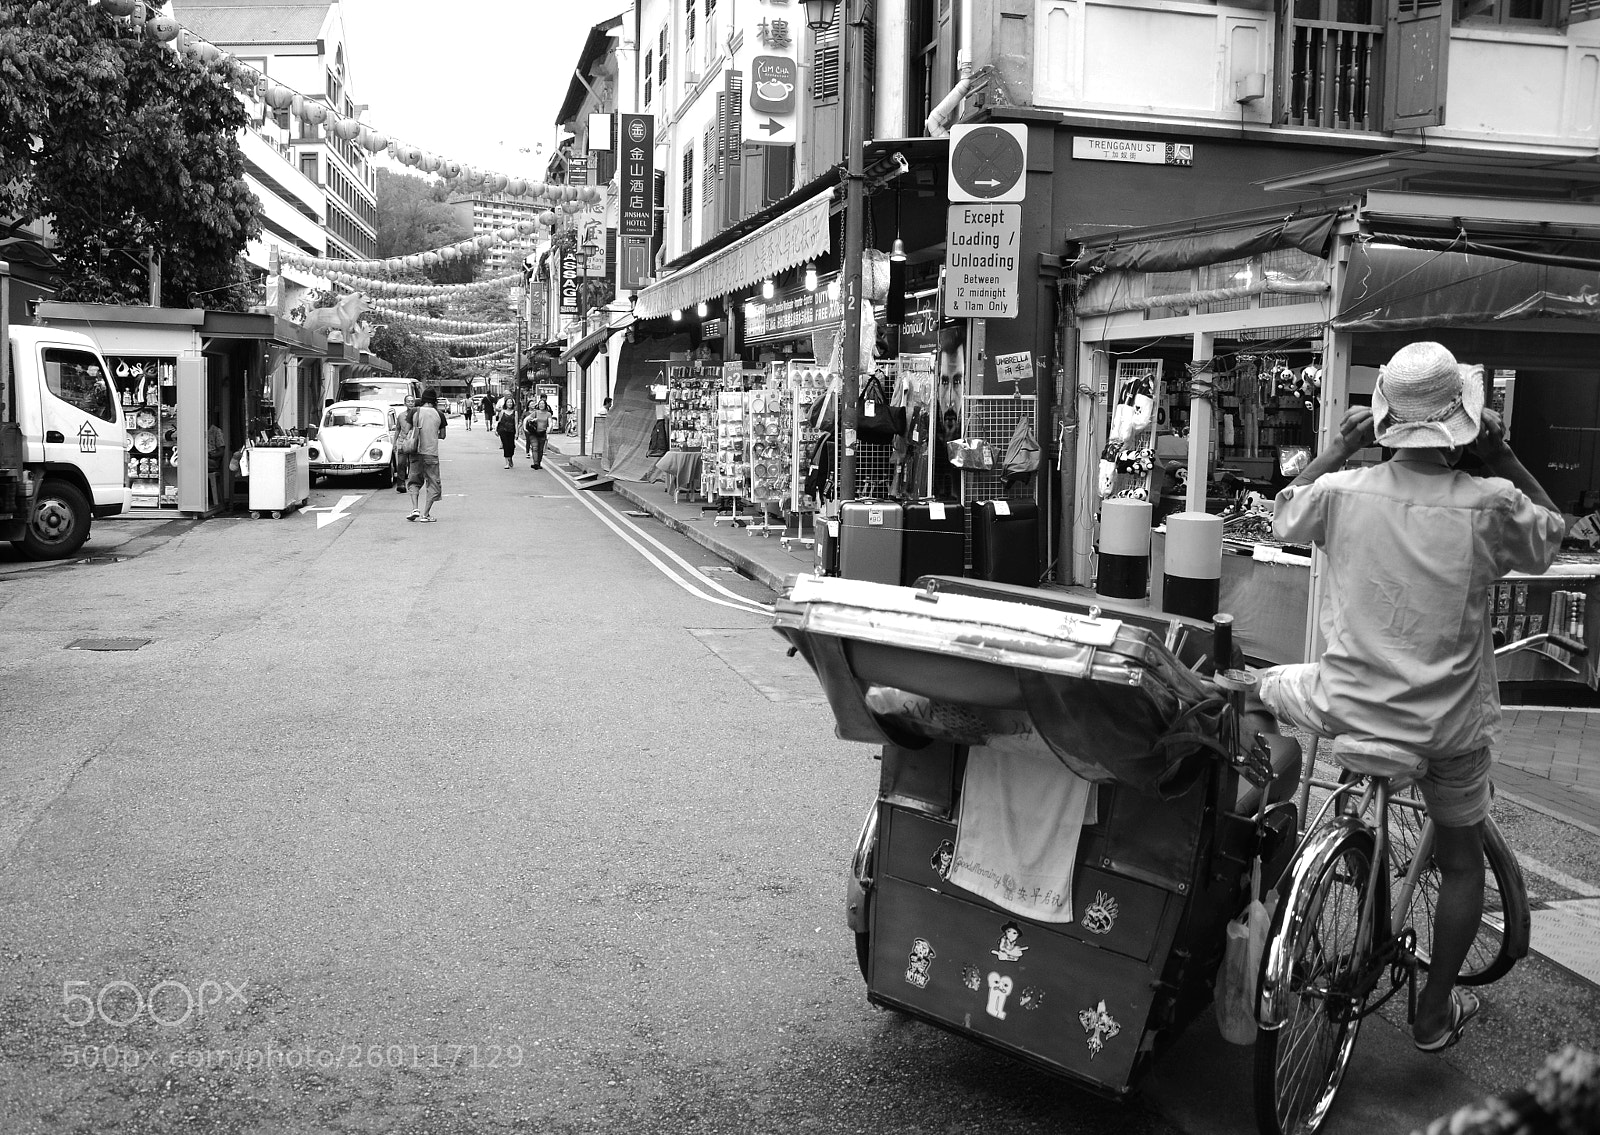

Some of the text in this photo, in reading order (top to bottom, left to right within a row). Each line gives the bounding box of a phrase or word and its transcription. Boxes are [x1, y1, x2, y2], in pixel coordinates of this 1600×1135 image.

[757, 60, 790, 80] YUM CHA
[1088, 139, 1157, 153] TRENGGANU ST
[629, 147, 645, 209] 金山酒店
[623, 211, 650, 219] JINSHAN
[964, 209, 1005, 228] Except
[626, 219, 647, 227] HOTEL
[952, 231, 1015, 249] Loading /
[951, 253, 1014, 271] Unloading
[562, 249, 577, 306] ASSAGE
[963, 273, 1000, 284] Between
[814, 290, 828, 305] DUTY
[957, 287, 1006, 300] 12 midnight
[815, 307, 829, 321] FREE
[953, 300, 1008, 314] & 11am Only
[995, 354, 1029, 366] UMBRELLA
[726, 372, 741, 389] $2
